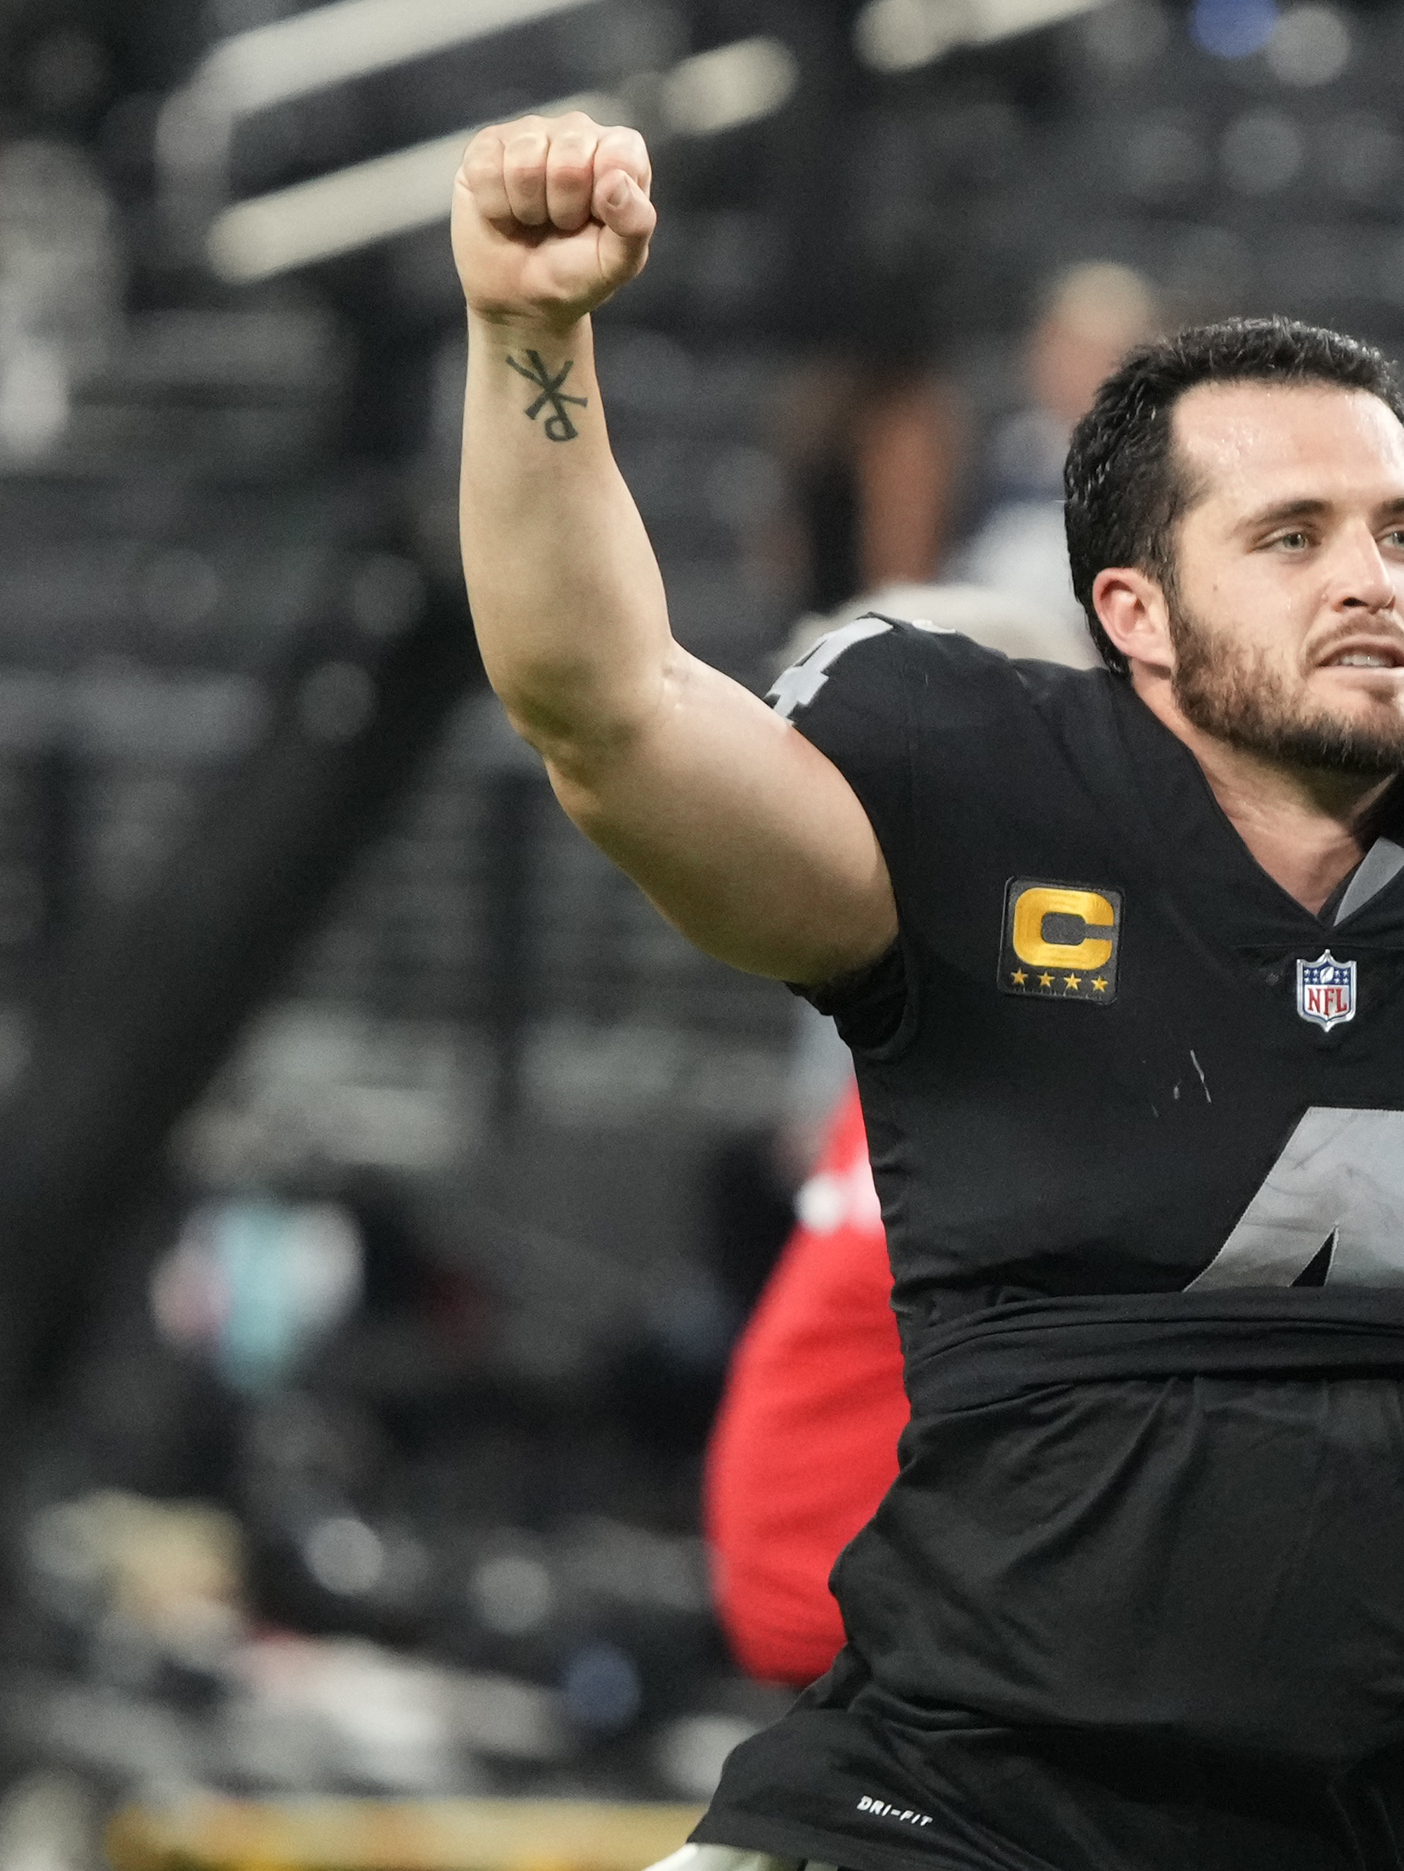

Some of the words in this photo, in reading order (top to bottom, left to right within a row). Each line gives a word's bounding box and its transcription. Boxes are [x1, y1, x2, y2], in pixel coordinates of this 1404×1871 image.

[1012, 887, 1115, 971] C
[1307, 988, 1348, 1016] NFL
[856, 1795, 933, 1827] DRI-FIT
